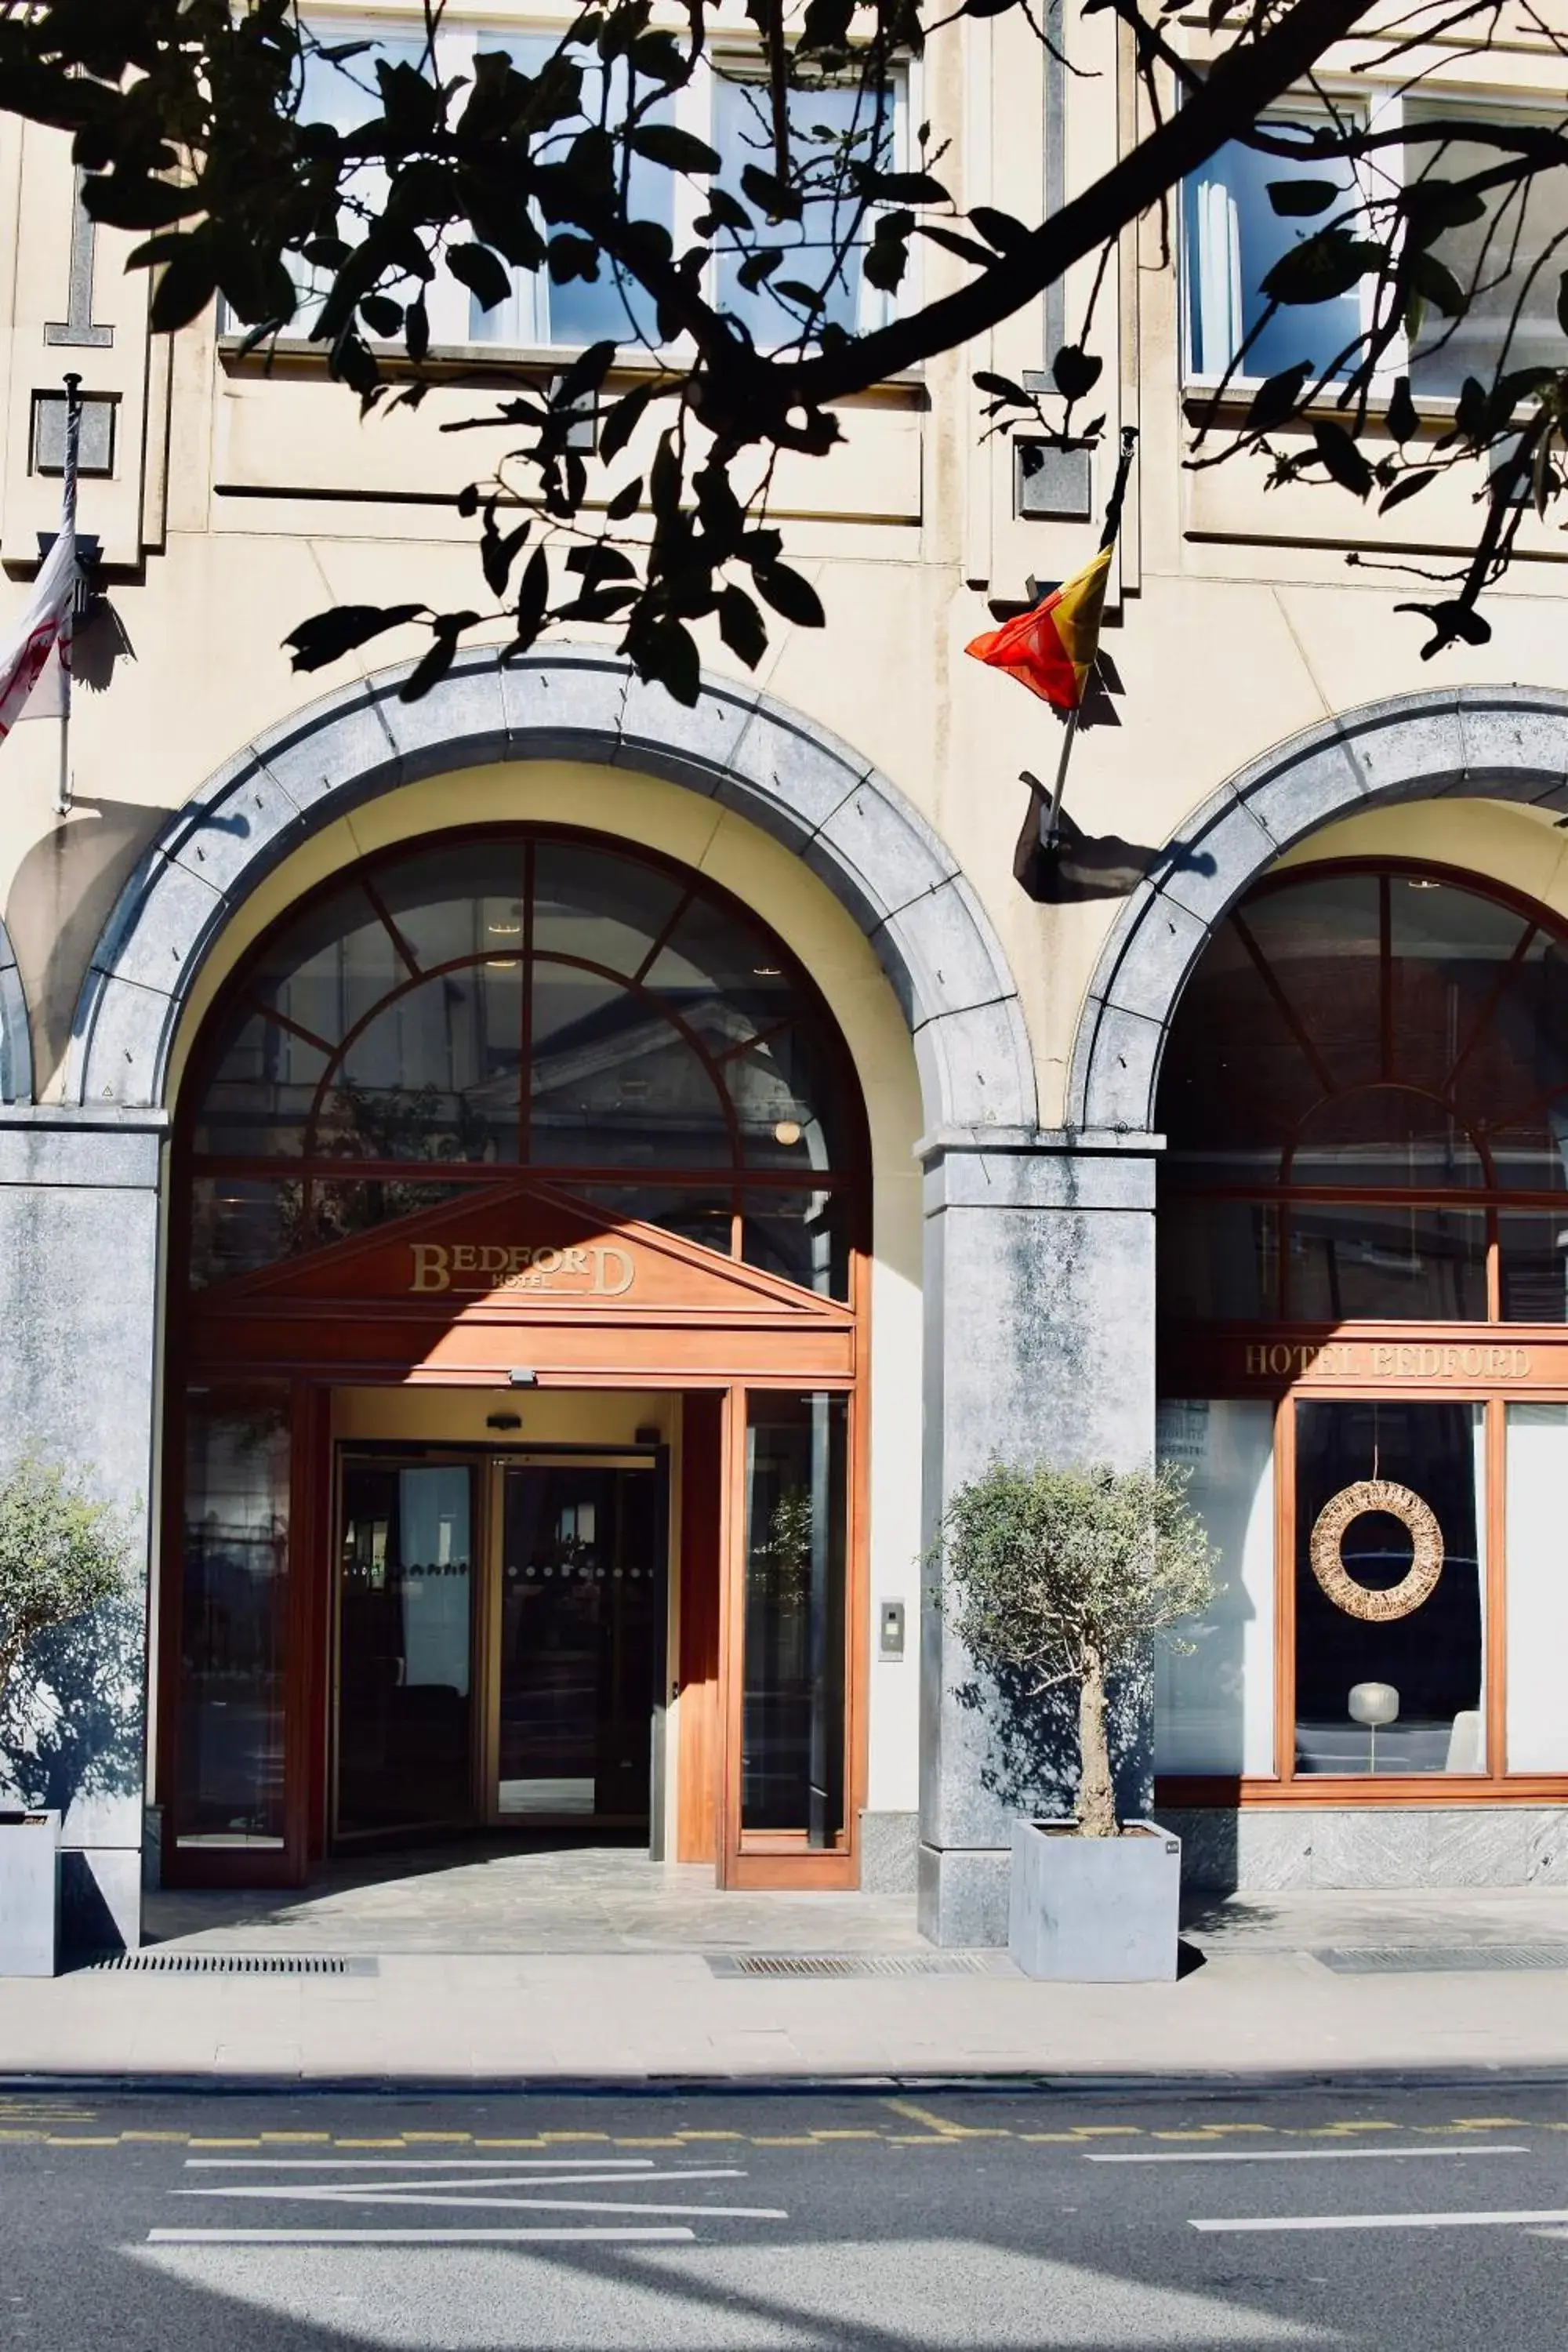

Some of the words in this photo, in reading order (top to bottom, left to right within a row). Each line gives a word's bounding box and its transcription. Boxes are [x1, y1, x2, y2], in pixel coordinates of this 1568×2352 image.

[408, 1243, 636, 1296] BEDFORD
[492, 1274, 551, 1287] HOTEL
[1247, 1345, 1360, 1376] HOTEL
[1370, 1347, 1531, 1378] BEDFORD
